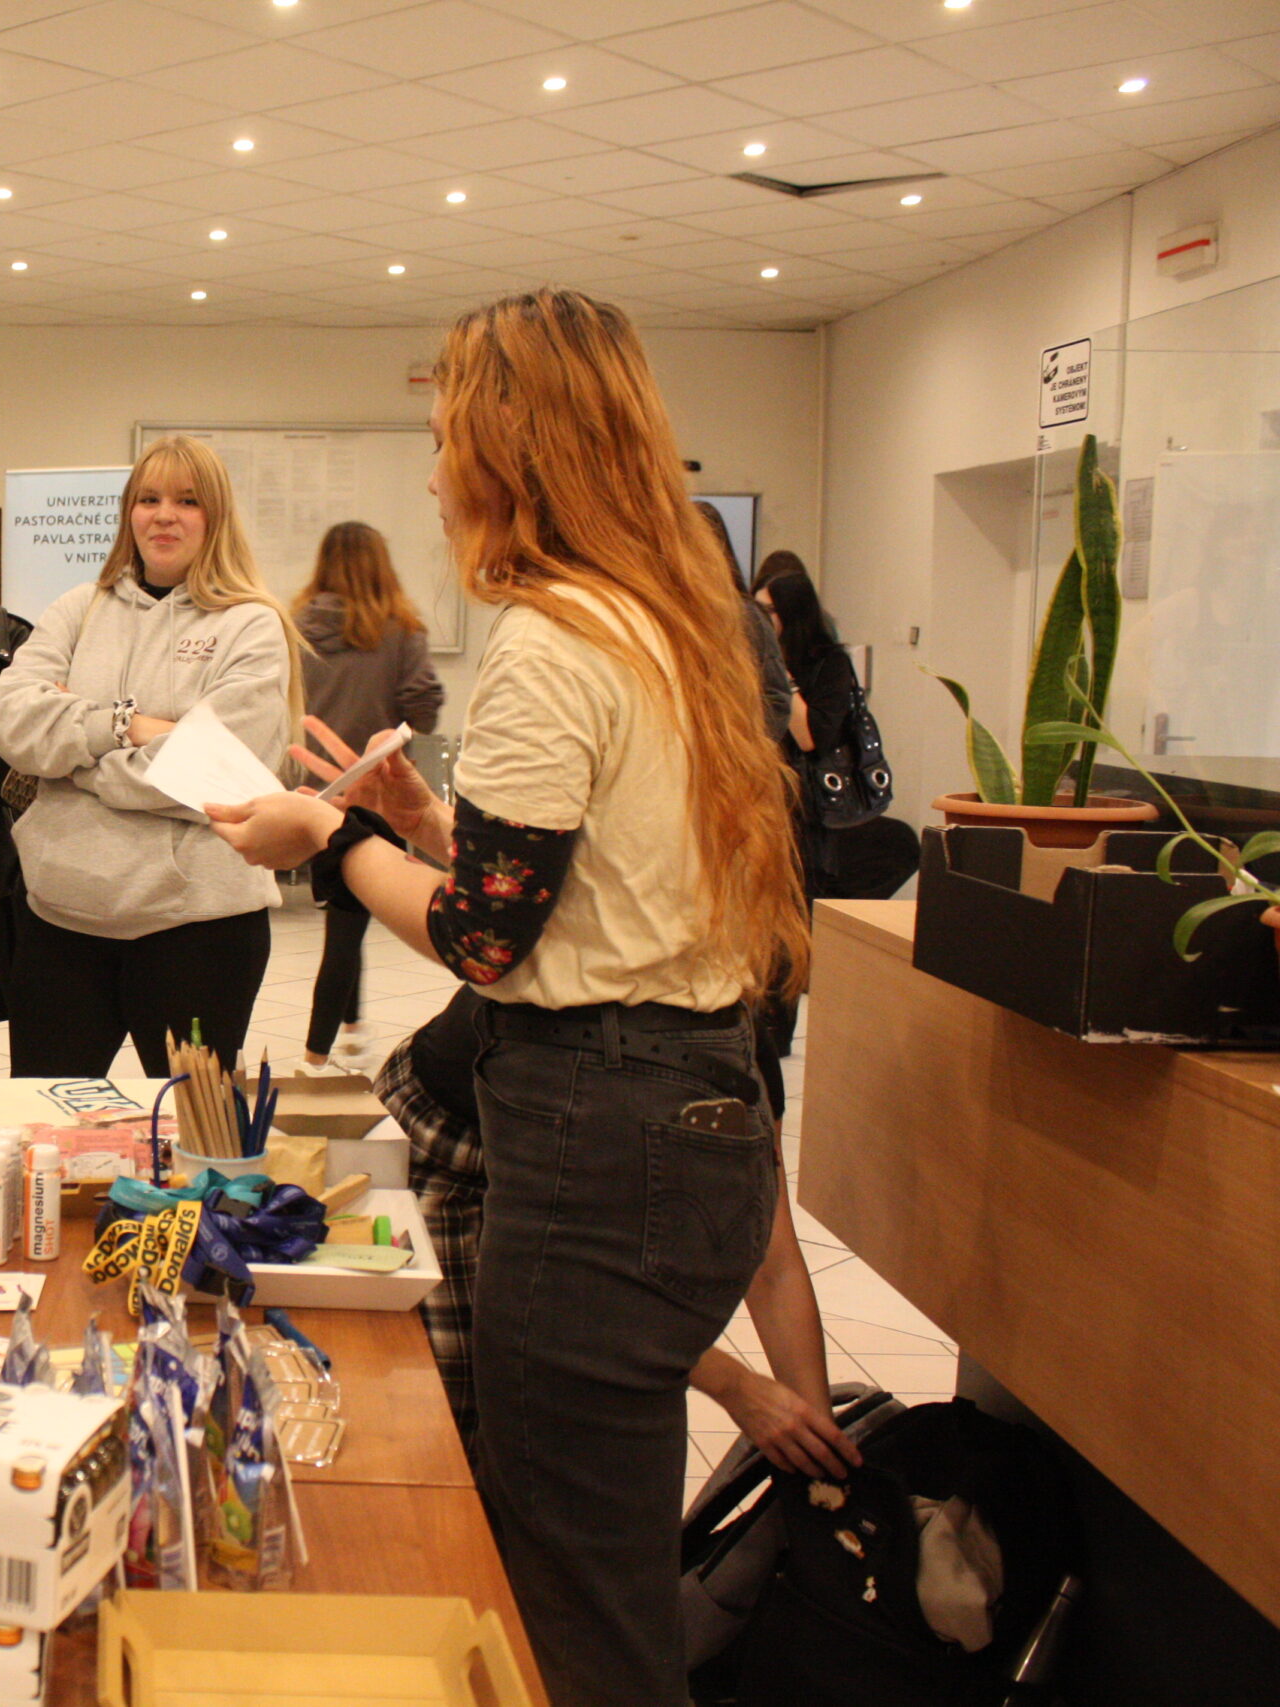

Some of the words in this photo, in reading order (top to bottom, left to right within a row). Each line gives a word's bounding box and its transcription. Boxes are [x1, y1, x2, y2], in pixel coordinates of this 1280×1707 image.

[14, 512, 103, 526] PASTORAČNÉ
[33, 533, 75, 544] PAVLA
[64, 553, 73, 563] V
[177, 635, 217, 655] 222
[32, 1172, 46, 1256] magnesium
[44, 1220, 55, 1255] SHOT
[158, 1209, 196, 1296] Donald's
